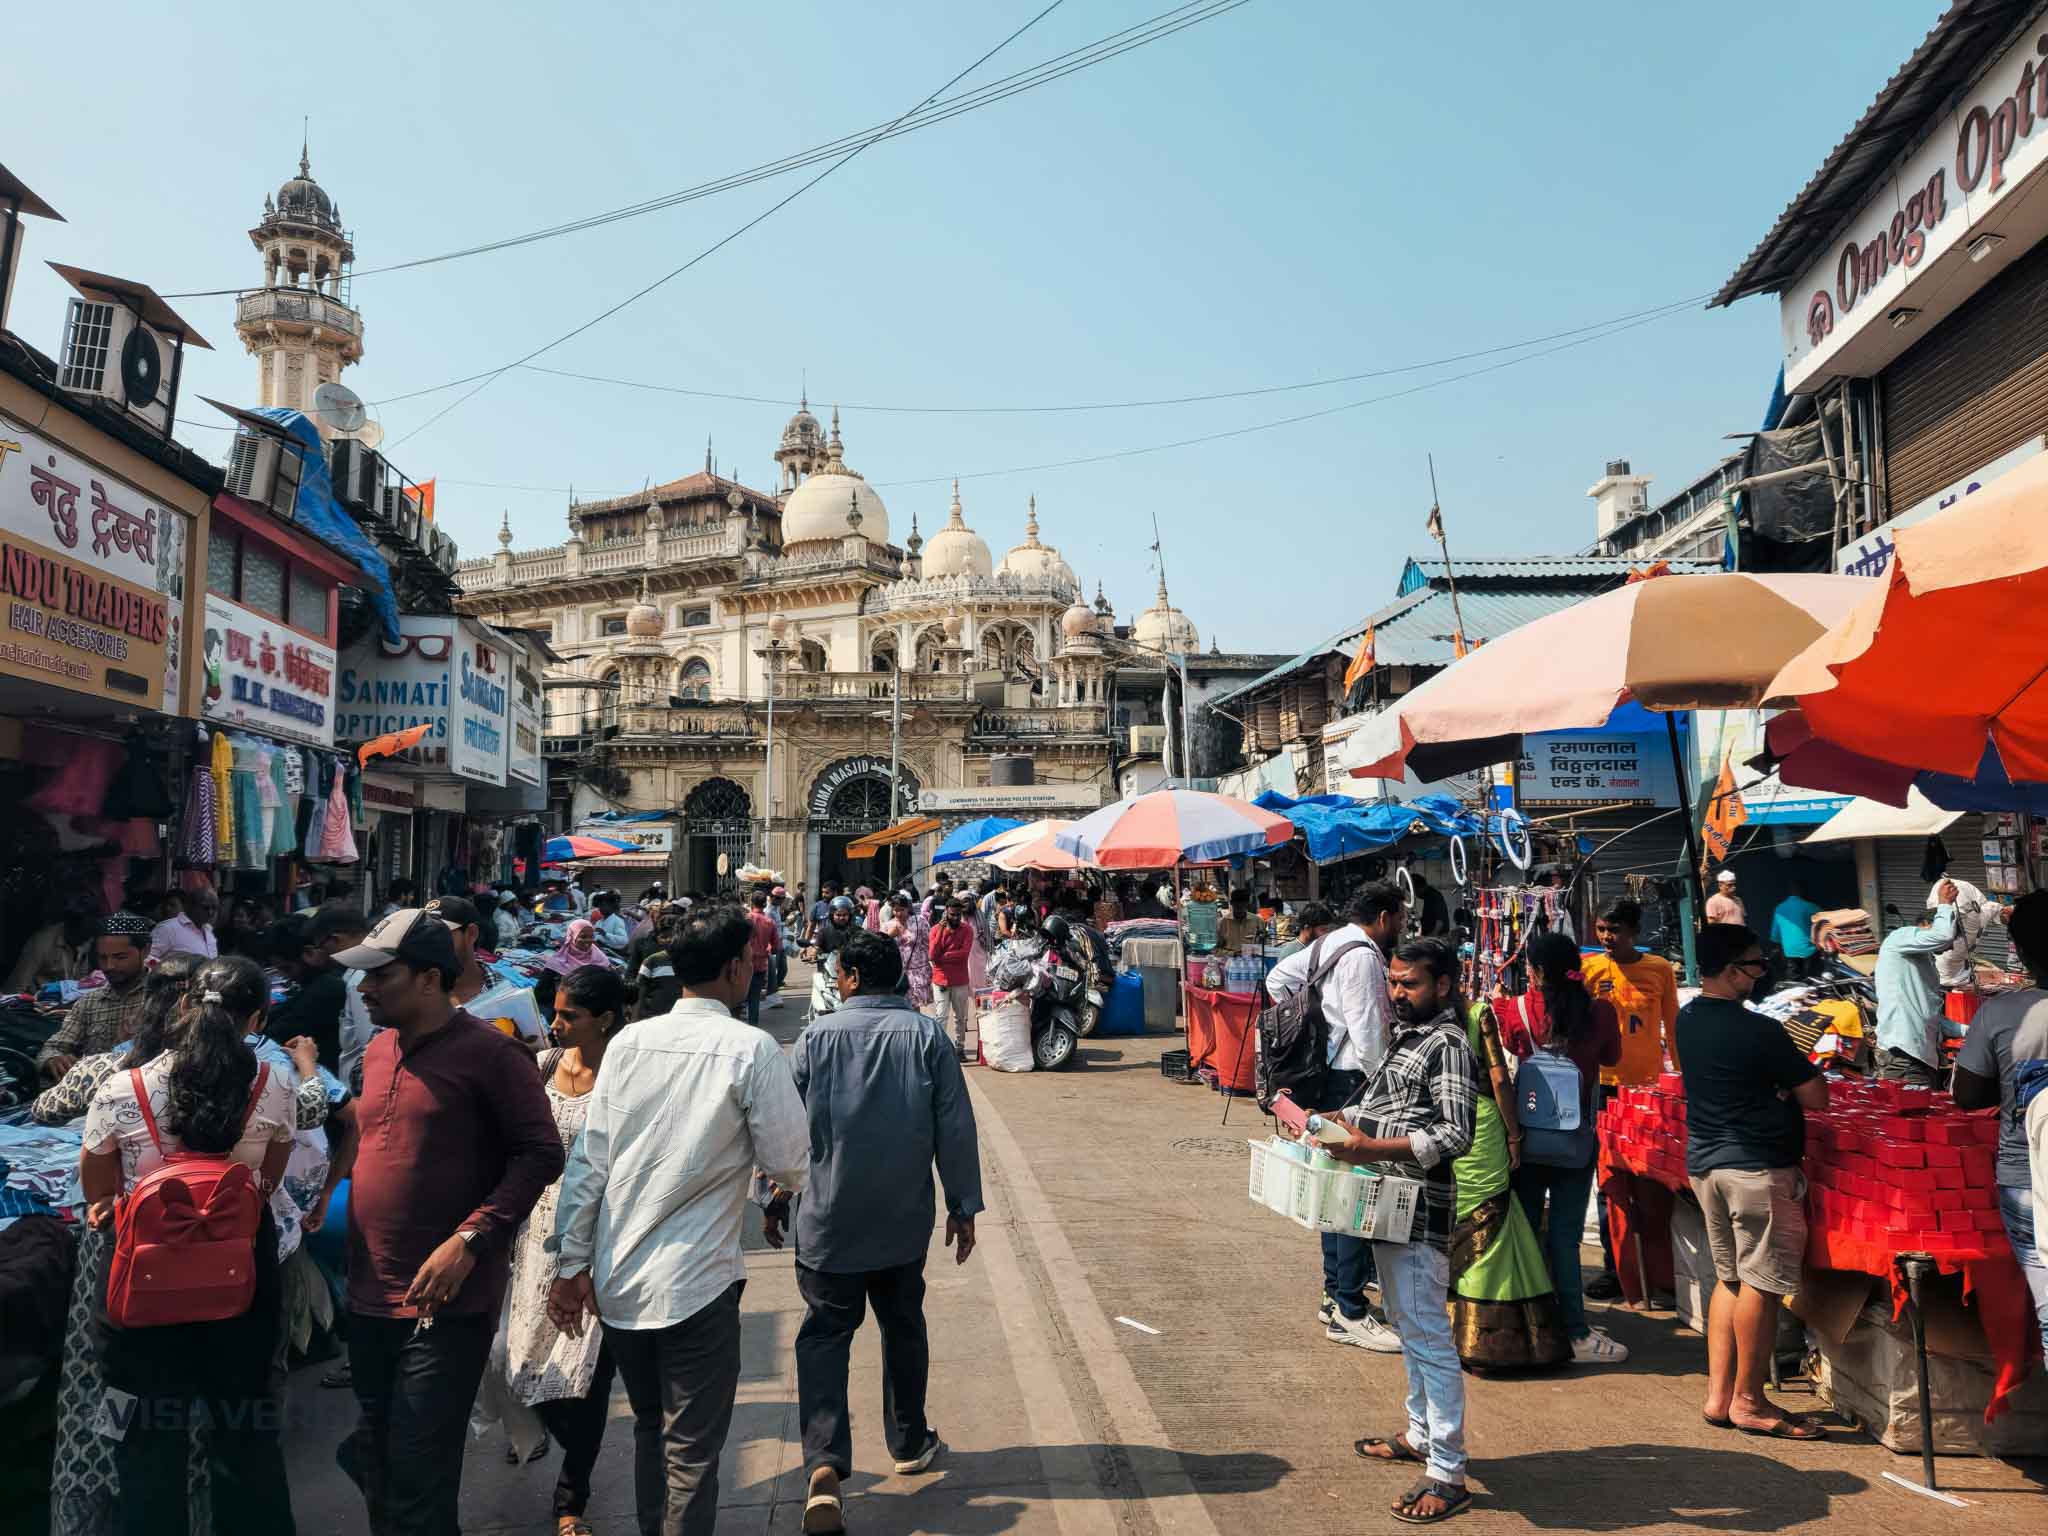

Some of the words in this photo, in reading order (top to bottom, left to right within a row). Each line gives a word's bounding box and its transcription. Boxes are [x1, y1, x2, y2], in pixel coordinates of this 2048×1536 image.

[1836, 166, 1947, 313] Omega
[10, 601, 43, 637] HAIR
[47, 615, 129, 662] ACCESSORIES
[64, 566, 168, 645] TRADERS
[1548, 741, 1637, 754] रमणलाल
[813, 783, 834, 814] JUMA
[829, 760, 869, 786] MASJID
